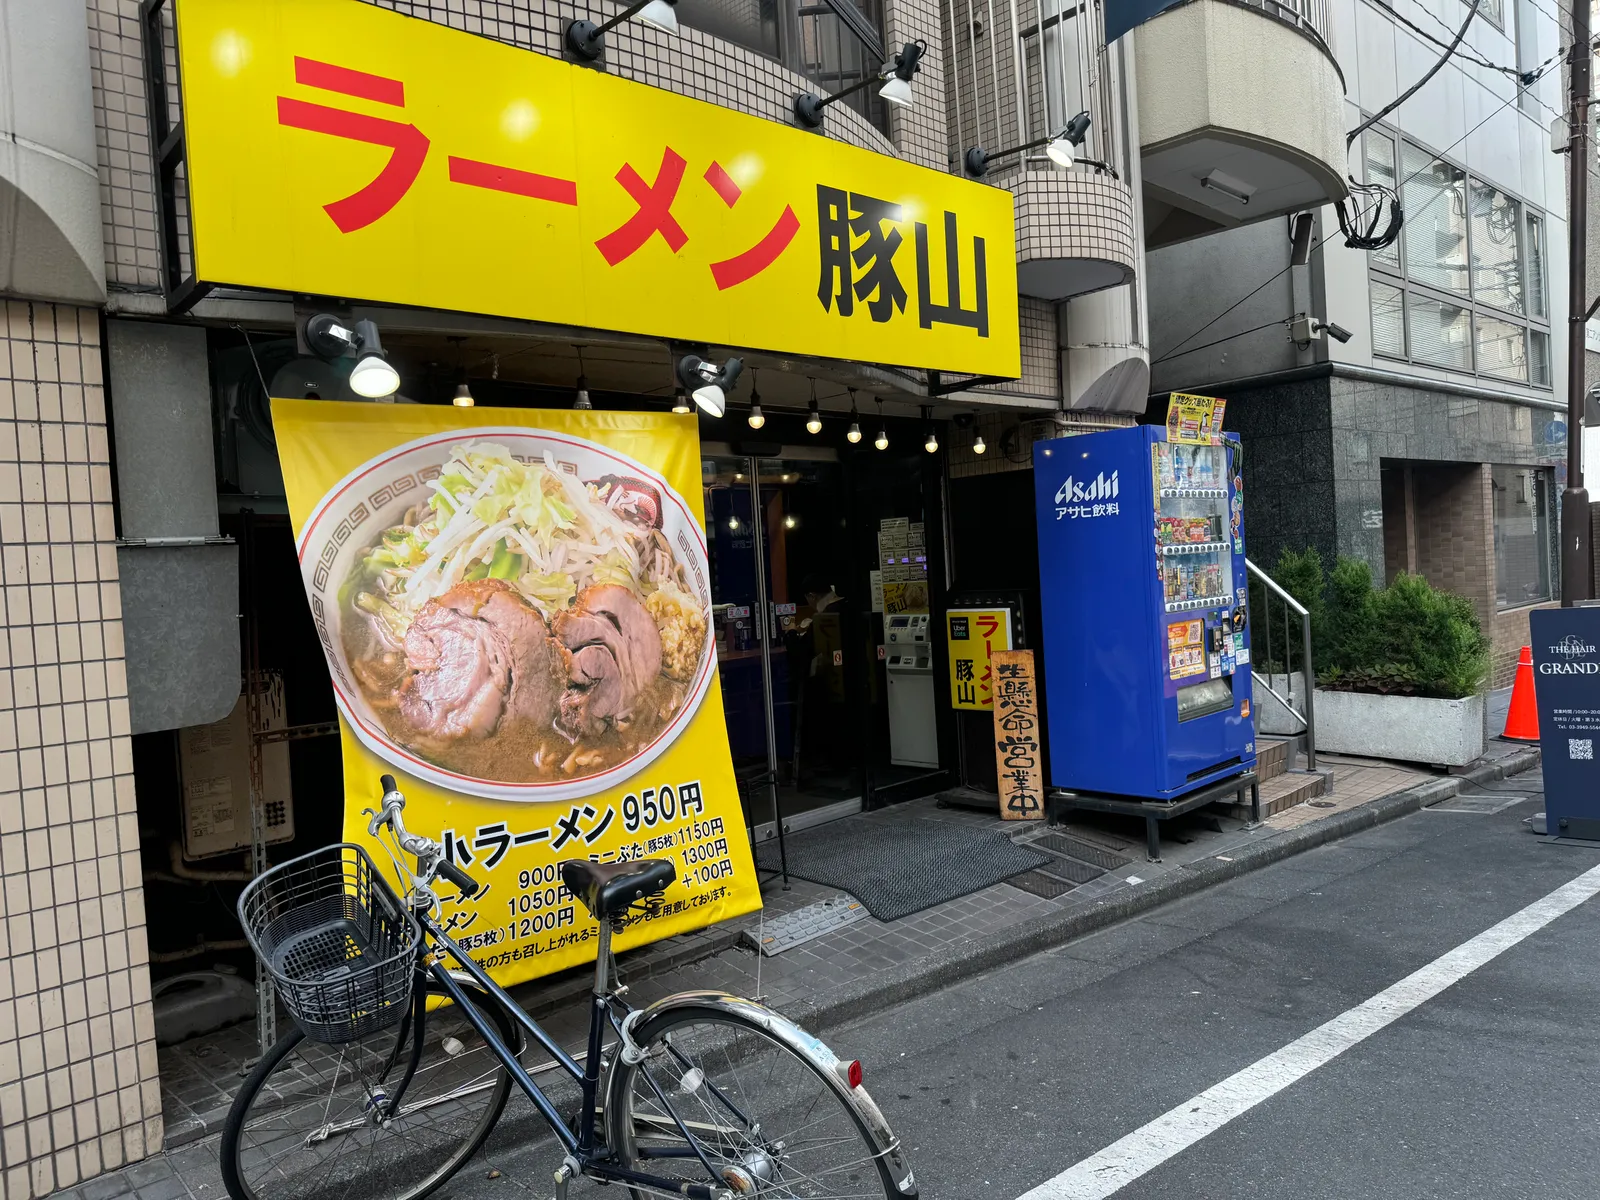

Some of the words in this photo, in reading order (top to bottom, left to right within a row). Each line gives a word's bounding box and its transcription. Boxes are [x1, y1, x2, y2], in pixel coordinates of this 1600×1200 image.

[1055, 470, 1119, 505] Asahi
[1055, 503, 1120, 520] アサヒ飲料
[1548, 645, 1571, 653] THE
[1571, 645, 1597, 653] HAIR
[956, 659, 976, 705] 豚山
[1539, 663, 1600, 675] GRAND
[623, 782, 703, 832] 950円
[678, 817, 724, 845] 1150円
[682, 838, 728, 866] 1300円
[682, 859, 733, 889] +100円
[508, 885, 574, 917] 1050円
[508, 906, 574, 940] 1200円
